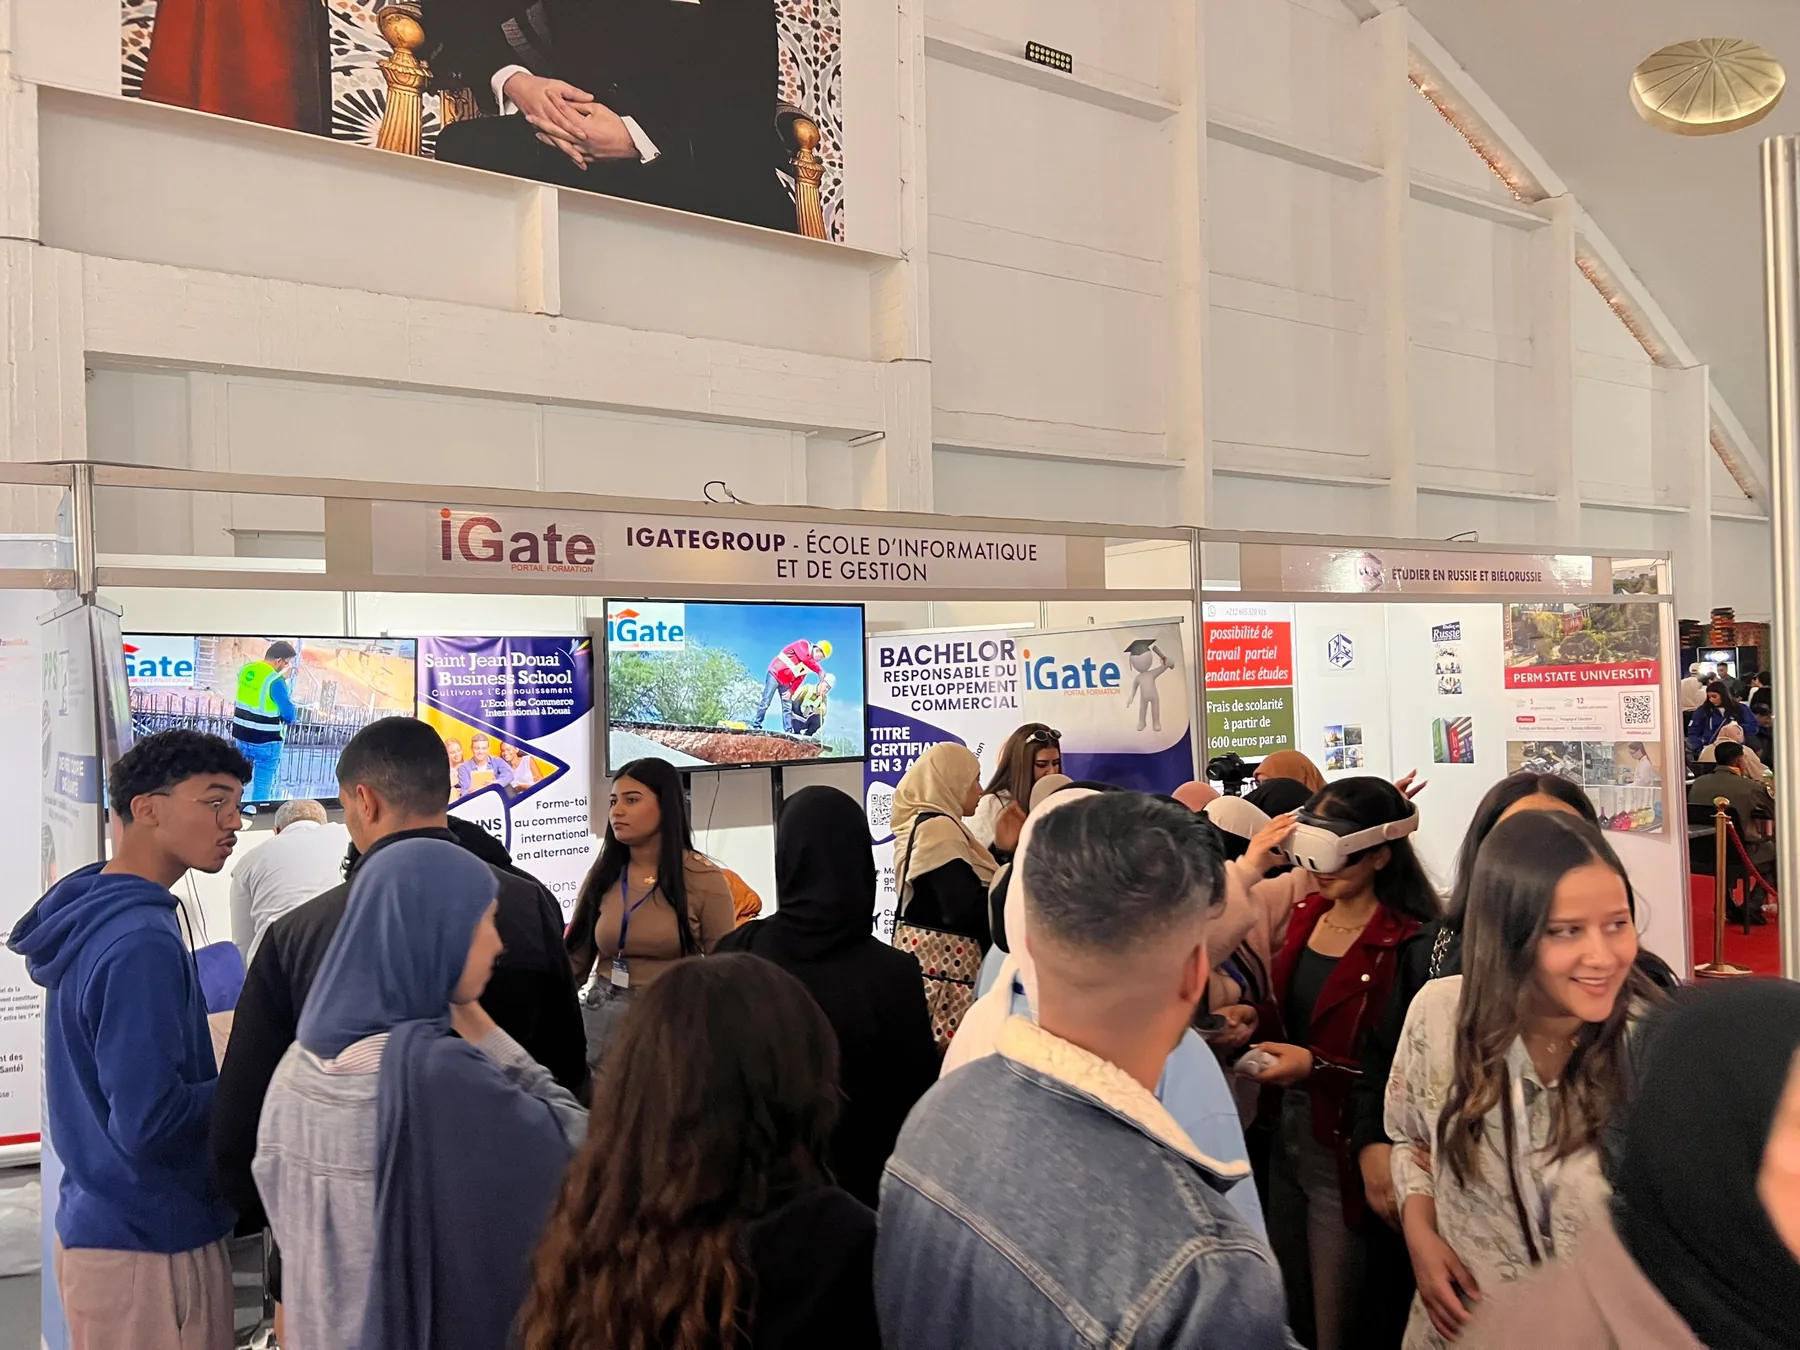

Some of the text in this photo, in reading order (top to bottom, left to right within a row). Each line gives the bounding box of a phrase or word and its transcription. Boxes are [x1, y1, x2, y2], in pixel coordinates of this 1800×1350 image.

[440, 508, 596, 566] iGate
[626, 526, 786, 552] IGATEGROUP
[806, 529, 870, 555] ÉCOLE
[511, 563, 593, 574] PORTAIL FORMATION
[777, 559, 927, 581] ET DE GESTION
[1391, 566, 1542, 582] ÉTUDIER EN RUSSIE ET BIÉLORUSSIE
[608, 614, 684, 642] iGate
[1210, 625, 1274, 643] possibilité de
[1434, 628, 1460, 640] Russie
[424, 652, 560, 670] Saint Jean Douai
[880, 639, 1015, 668] BACHELOR
[1207, 646, 1277, 663] travail partiel
[884, 664, 1016, 683] RESPONSABLE DU
[1023, 648, 1121, 690] iGate
[1243, 667, 1256, 681] les
[1257, 666, 1288, 680] études
[1513, 668, 1653, 683] PERM STATE UNIVERSITY
[438, 670, 572, 686] Business School
[432, 688, 483, 697] Cultivons
[891, 680, 1018, 697] DEVELOPPEMENT
[1064, 688, 1121, 697] PORTAIL FORMATION
[515, 699, 527, 707] de
[528, 698, 574, 707] Commerce
[911, 696, 1018, 711] COMMERCIAL
[1206, 697, 1283, 713] Frais de scolarité
[485, 706, 571, 718] International à Douai
[1223, 715, 1271, 732] à partir de
[870, 727, 910, 741] TITRE
[1231, 735, 1257, 747] euros
[1259, 735, 1274, 748] par
[1276, 734, 1287, 744] an
[870, 760, 890, 773] EN
[892, 759, 902, 772] 3
[536, 796, 588, 810] Forme-toi
[514, 814, 588, 828] au commerce
[521, 828, 589, 844] international
[516, 845, 590, 861] en alternance
[9, 1053, 23, 1062] des
